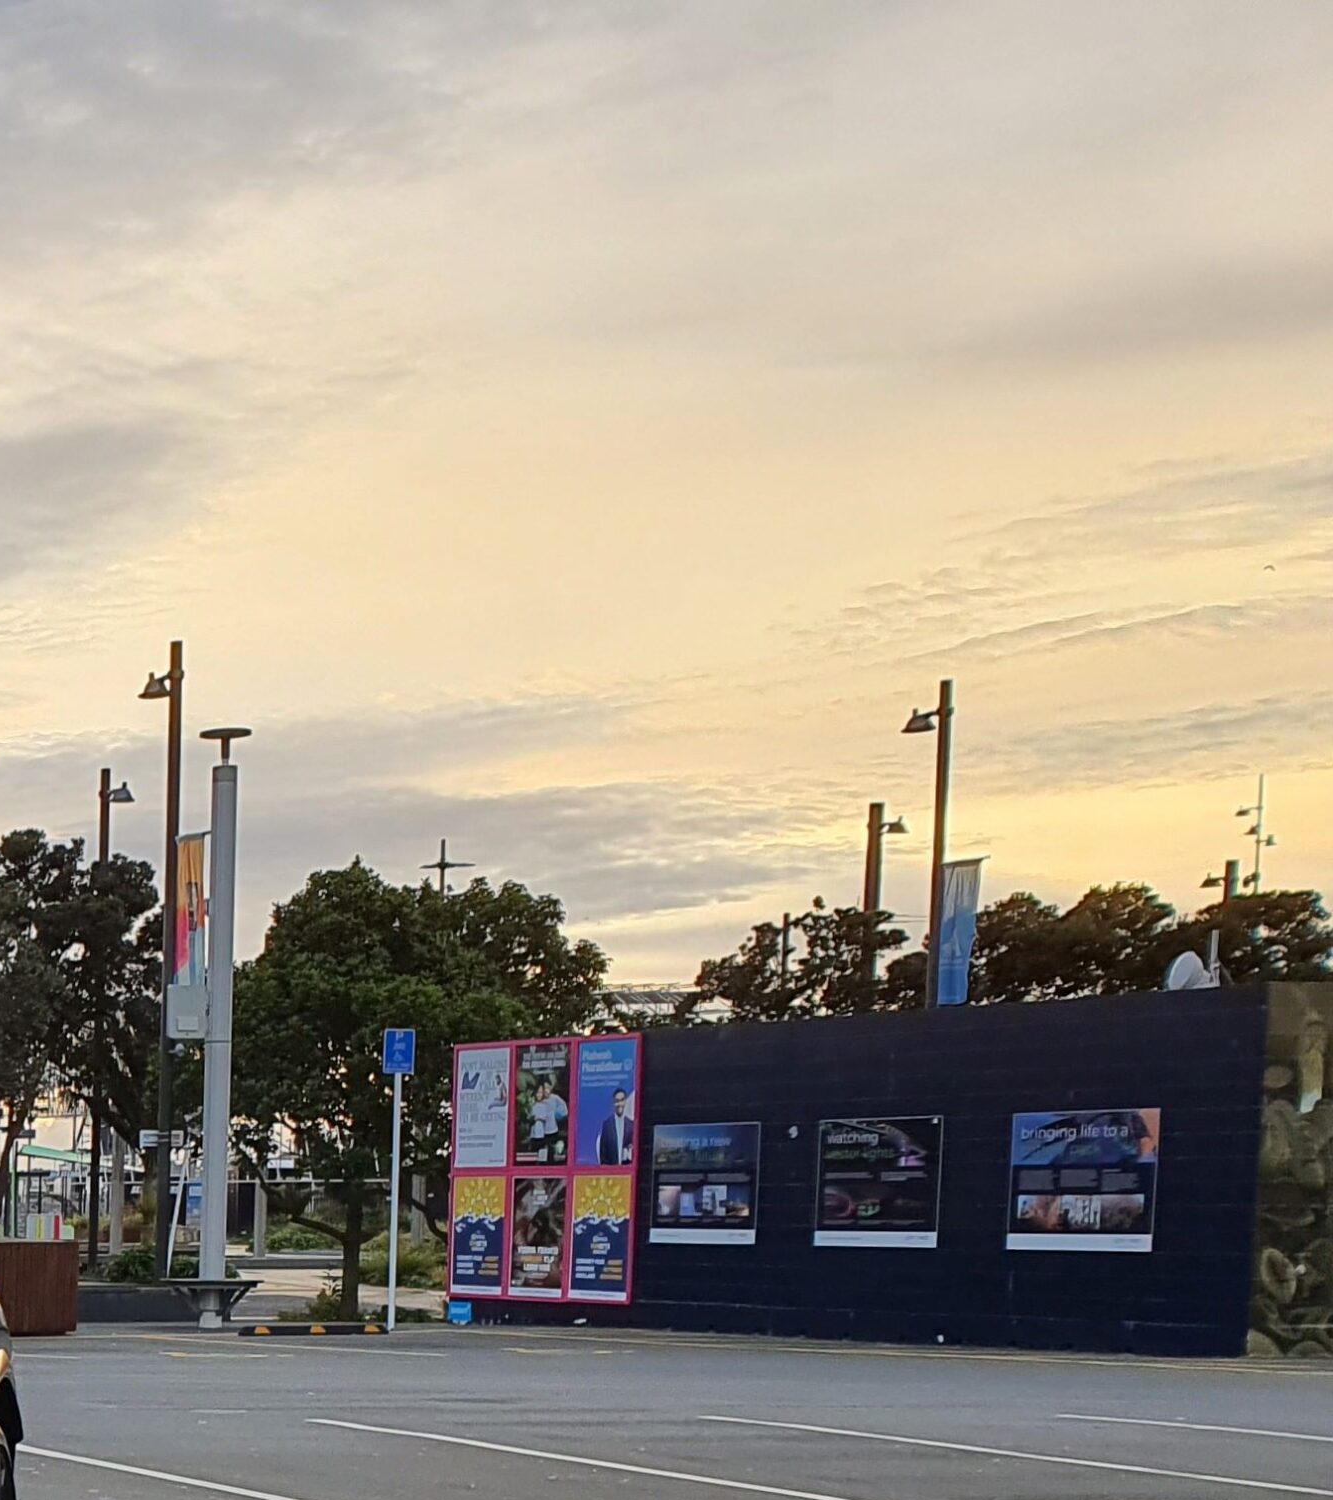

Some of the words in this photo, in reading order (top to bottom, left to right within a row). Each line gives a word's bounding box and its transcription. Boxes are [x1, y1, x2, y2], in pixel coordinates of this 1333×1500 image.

[827, 1132, 879, 1146] watching
[1021, 1126, 1077, 1141] bringing
[1080, 1124, 1100, 1137] life
[1104, 1124, 1117, 1137] to
[1120, 1126, 1129, 1137] a
